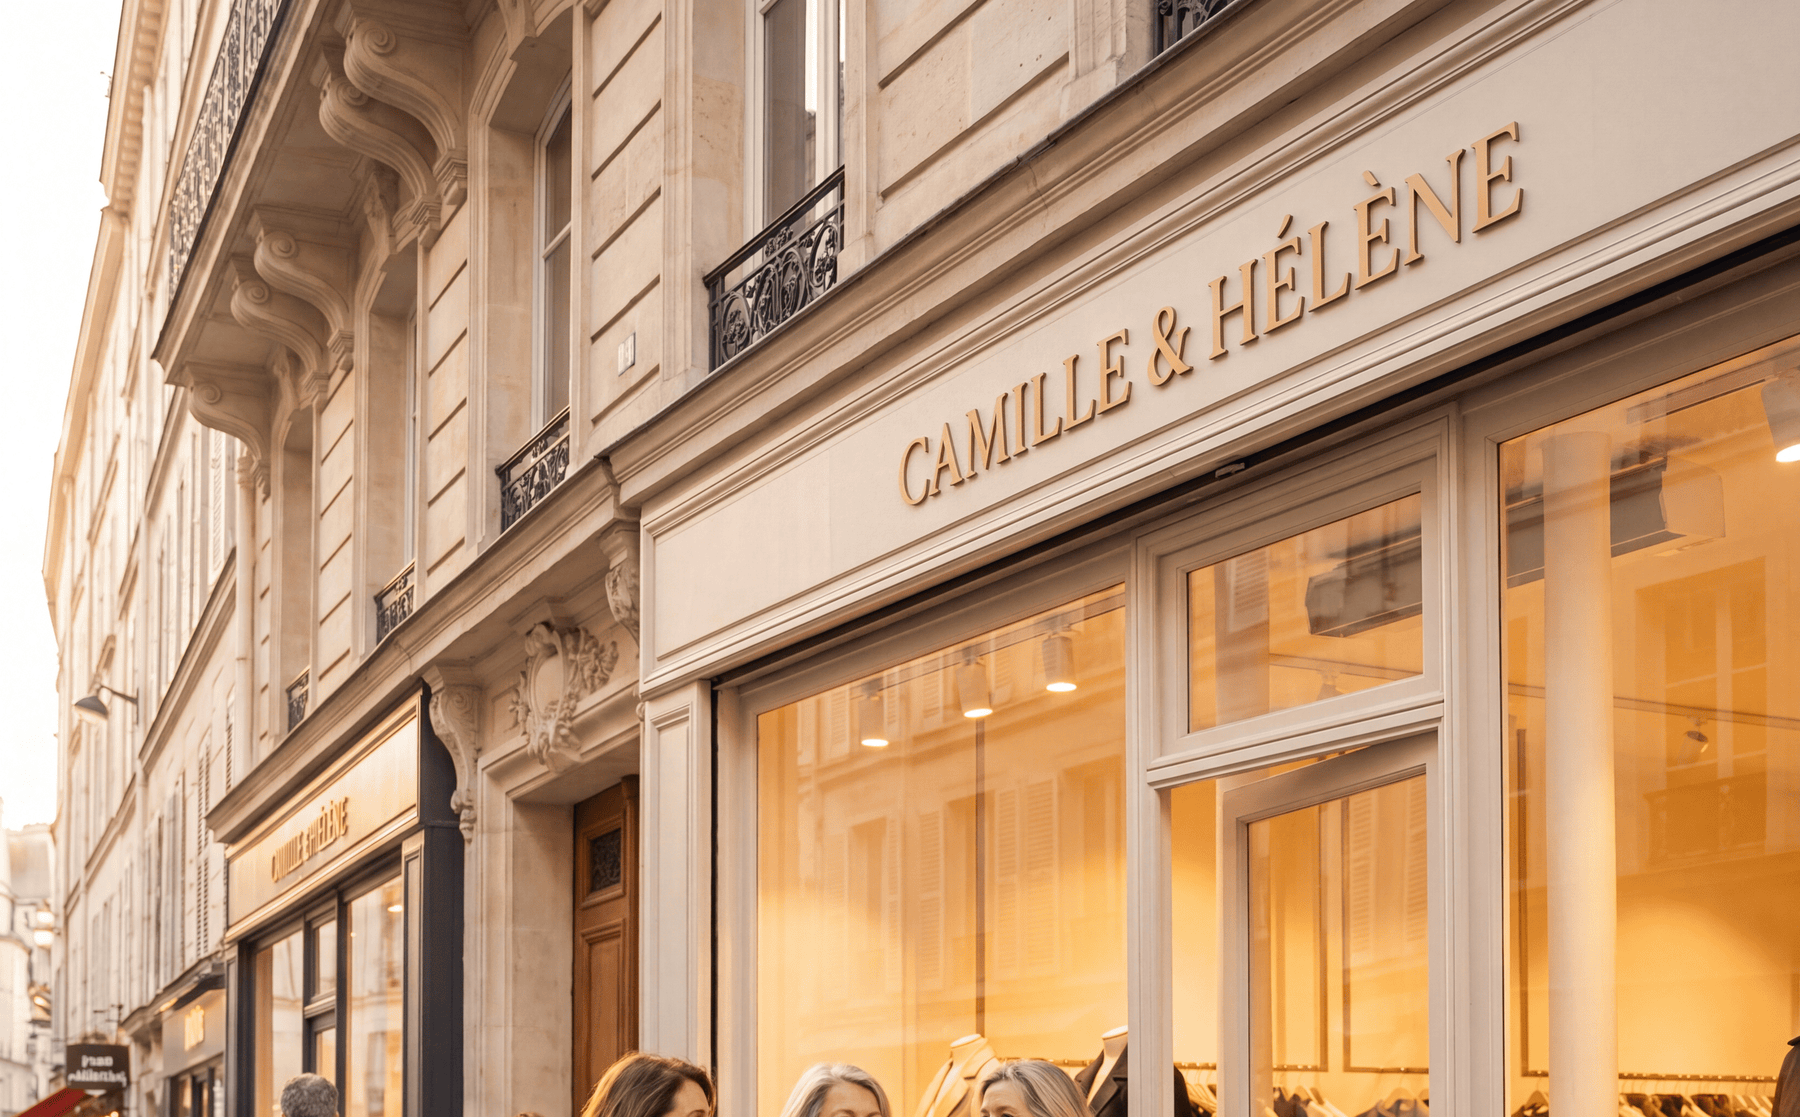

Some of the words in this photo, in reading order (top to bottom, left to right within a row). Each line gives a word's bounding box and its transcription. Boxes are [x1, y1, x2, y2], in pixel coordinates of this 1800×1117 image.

[898, 328, 1133, 506] CAMILLE
[1147, 306, 1194, 387] &
[1208, 120, 1524, 361] HÉLÈNE
